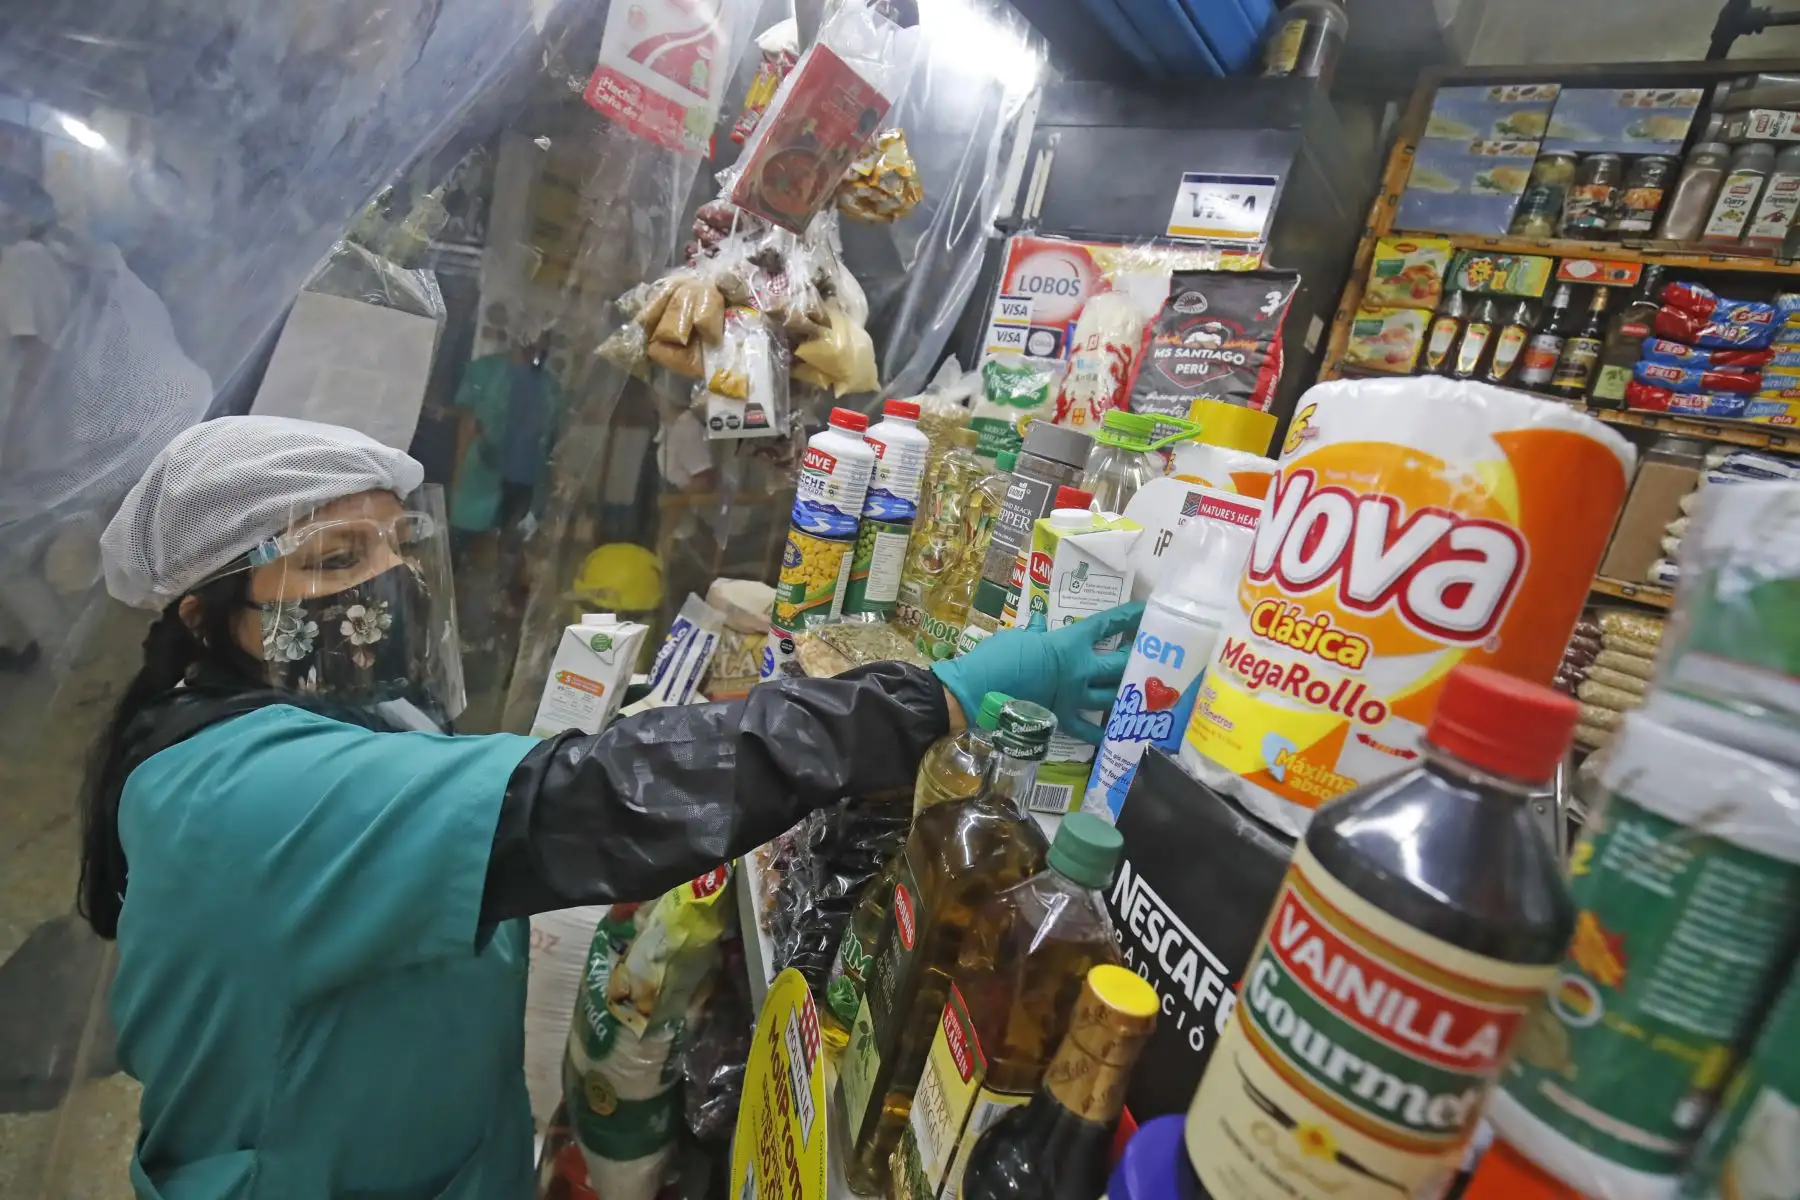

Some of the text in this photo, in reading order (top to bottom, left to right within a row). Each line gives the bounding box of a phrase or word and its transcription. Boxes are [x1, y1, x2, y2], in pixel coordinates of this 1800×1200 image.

[1018, 275, 1081, 297] LOBOS
[1002, 303, 1028, 316] VISA
[1260, 291, 1282, 316] 3
[997, 330, 1021, 343] VISA
[1175, 349, 1245, 366] SANTIAGO
[1014, 504, 1033, 516] BLACK
[1200, 503, 1237, 521] NATURE'S
[1031, 594, 1045, 611] Sin
[1250, 601, 1369, 670] Clásica
[1219, 636, 1388, 727] MegaRollo
[1275, 747, 1359, 794] Máxima
[1279, 903, 1500, 1062] VAINILLA
[926, 1065, 951, 1132] EXTRA
[919, 1086, 943, 1157] VIRGEN
